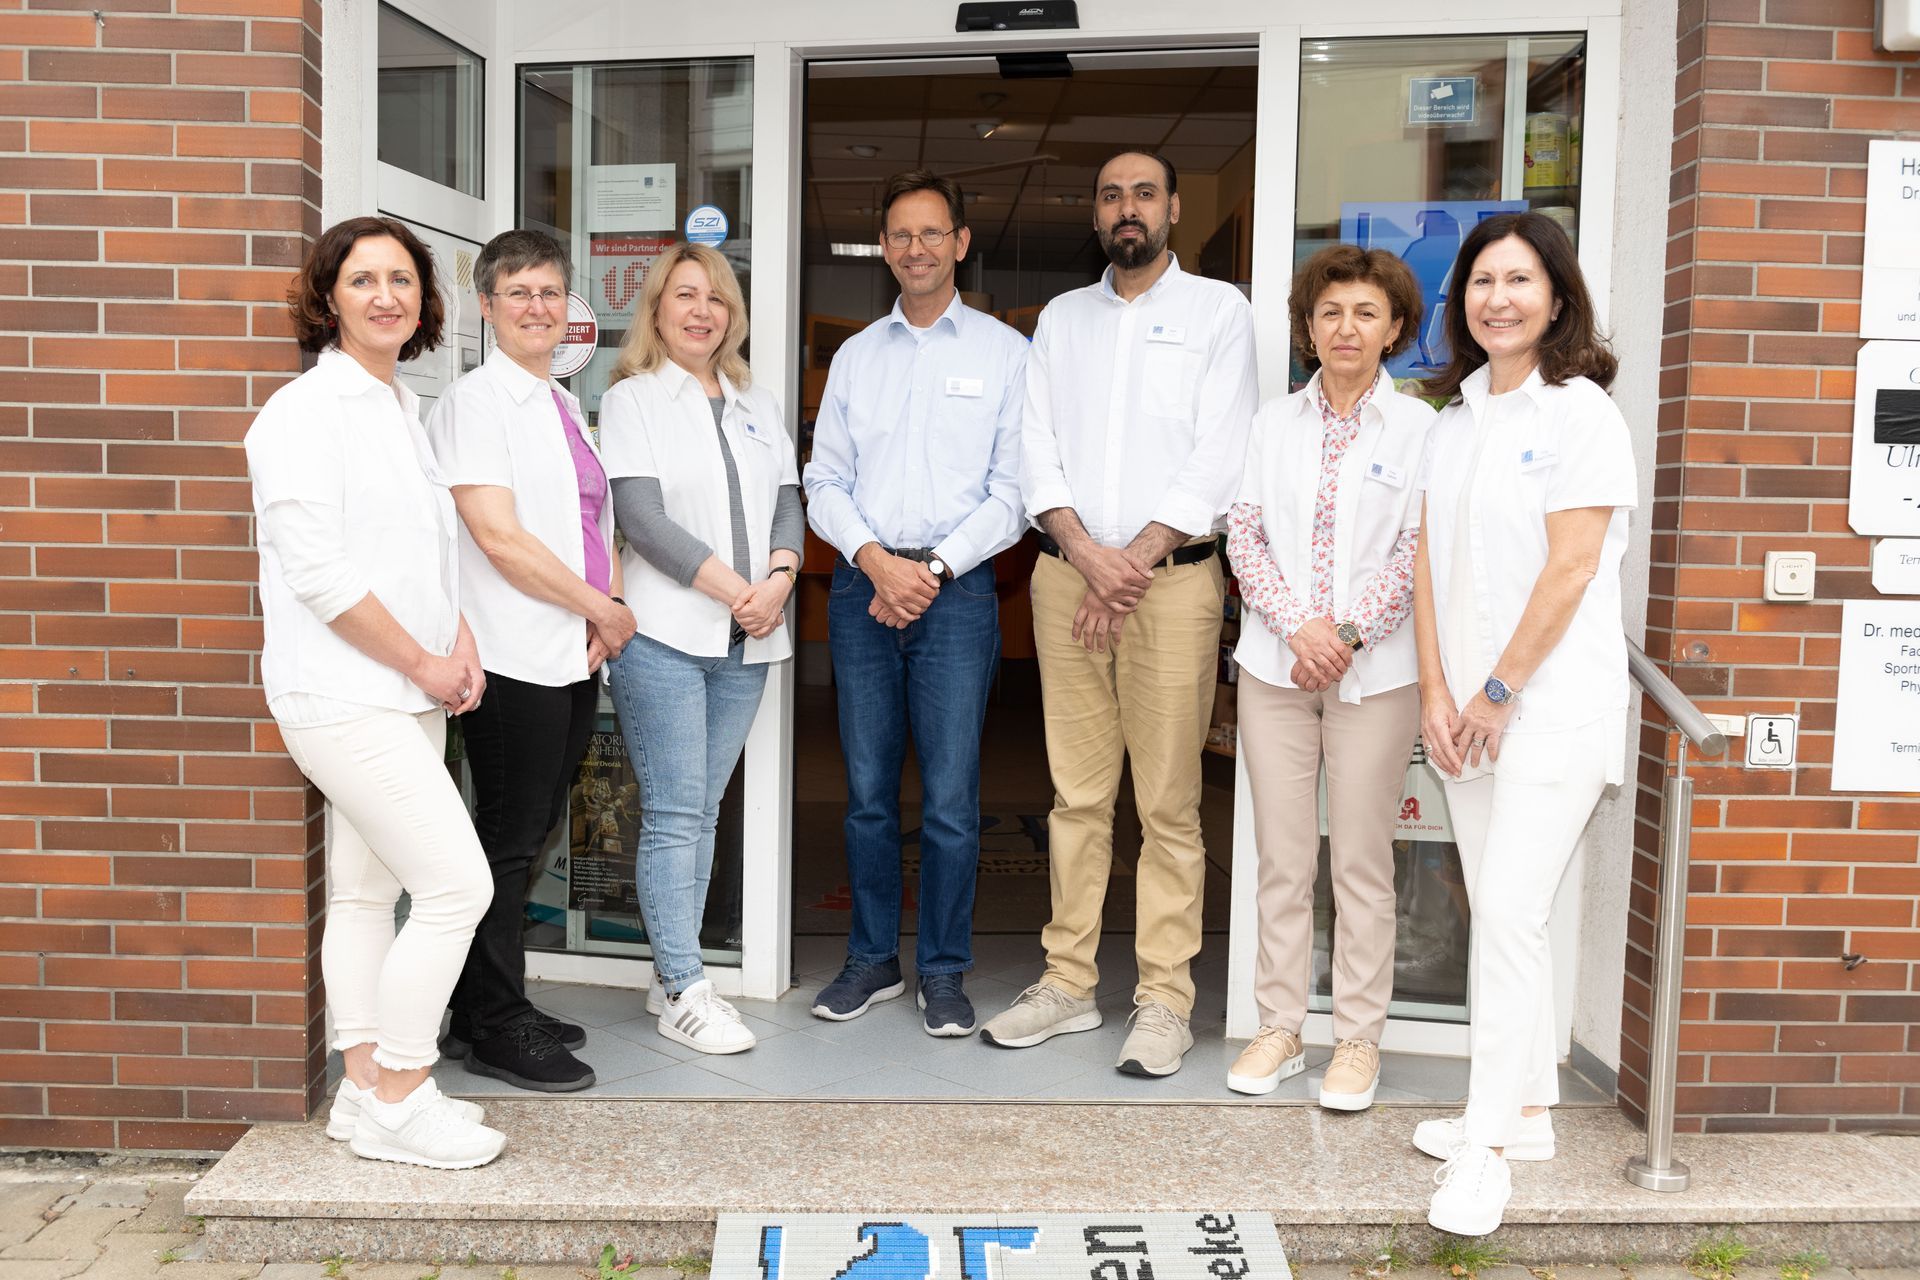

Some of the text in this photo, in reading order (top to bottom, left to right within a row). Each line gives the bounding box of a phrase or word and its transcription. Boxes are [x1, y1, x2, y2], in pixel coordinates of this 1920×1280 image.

[693, 217, 720, 227] SZI
[595, 244, 610, 252] Wir
[611, 244, 628, 252] sind
[629, 244, 657, 252] Partner
[1897, 312, 1916, 321] und
[567, 325, 590, 333] ZIERT
[1864, 623, 1884, 637] Dr.
